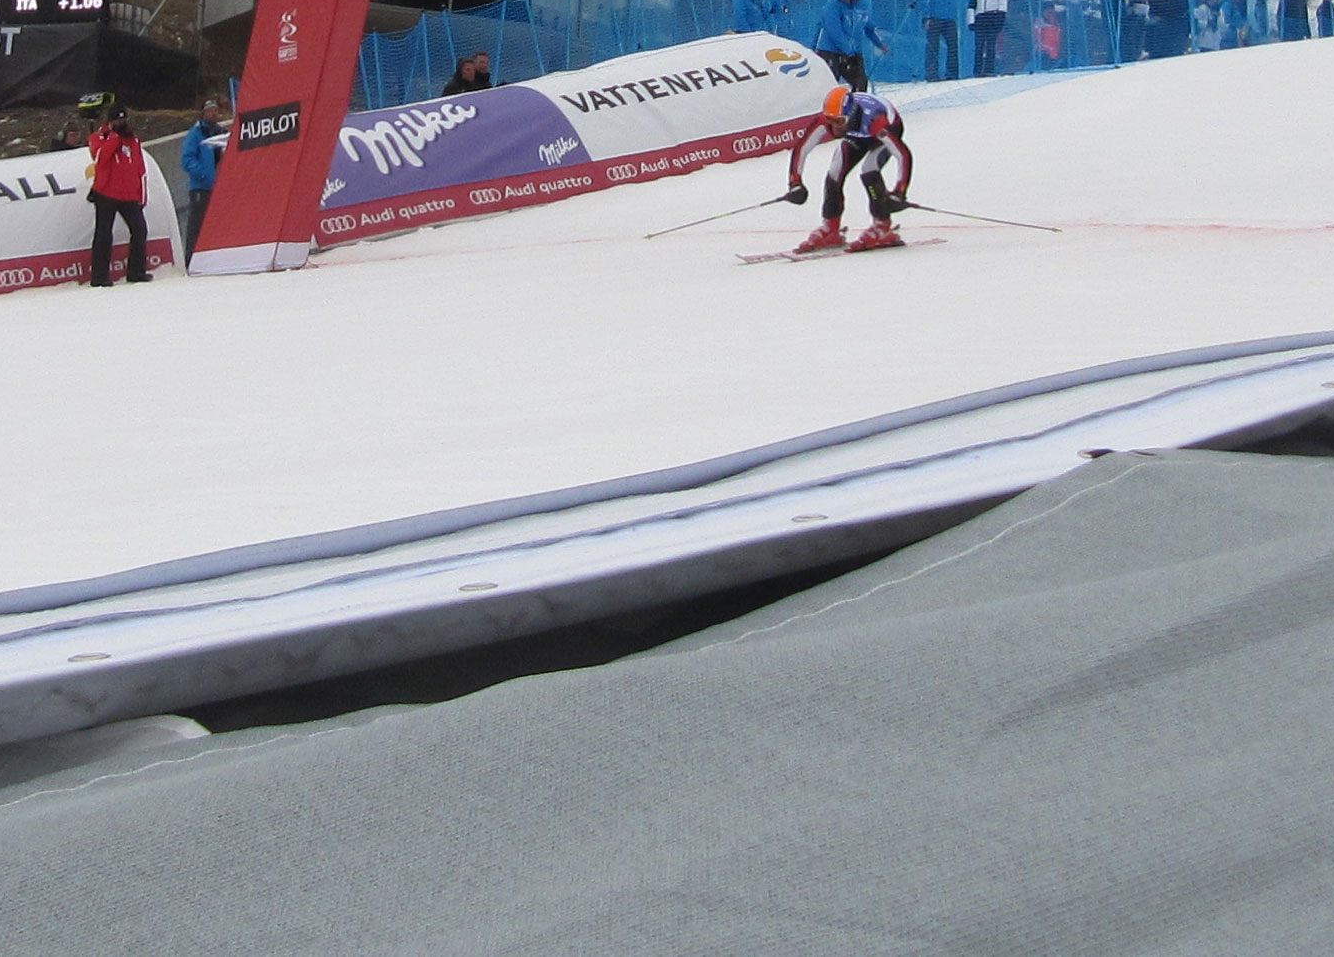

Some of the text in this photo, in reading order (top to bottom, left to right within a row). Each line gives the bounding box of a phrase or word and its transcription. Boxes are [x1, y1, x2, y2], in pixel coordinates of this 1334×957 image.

[560, 60, 770, 113] VATTENFALL
[240, 112, 299, 140] HUBLOT
[339, 102, 479, 175] Milka
[765, 129, 794, 146] Audi
[539, 137, 579, 167] Milka
[640, 147, 720, 174] Audi quattro
[504, 174, 592, 199] Audi quattro
[360, 197, 456, 226] Audi quattro
[39, 263, 83, 283] Audi
